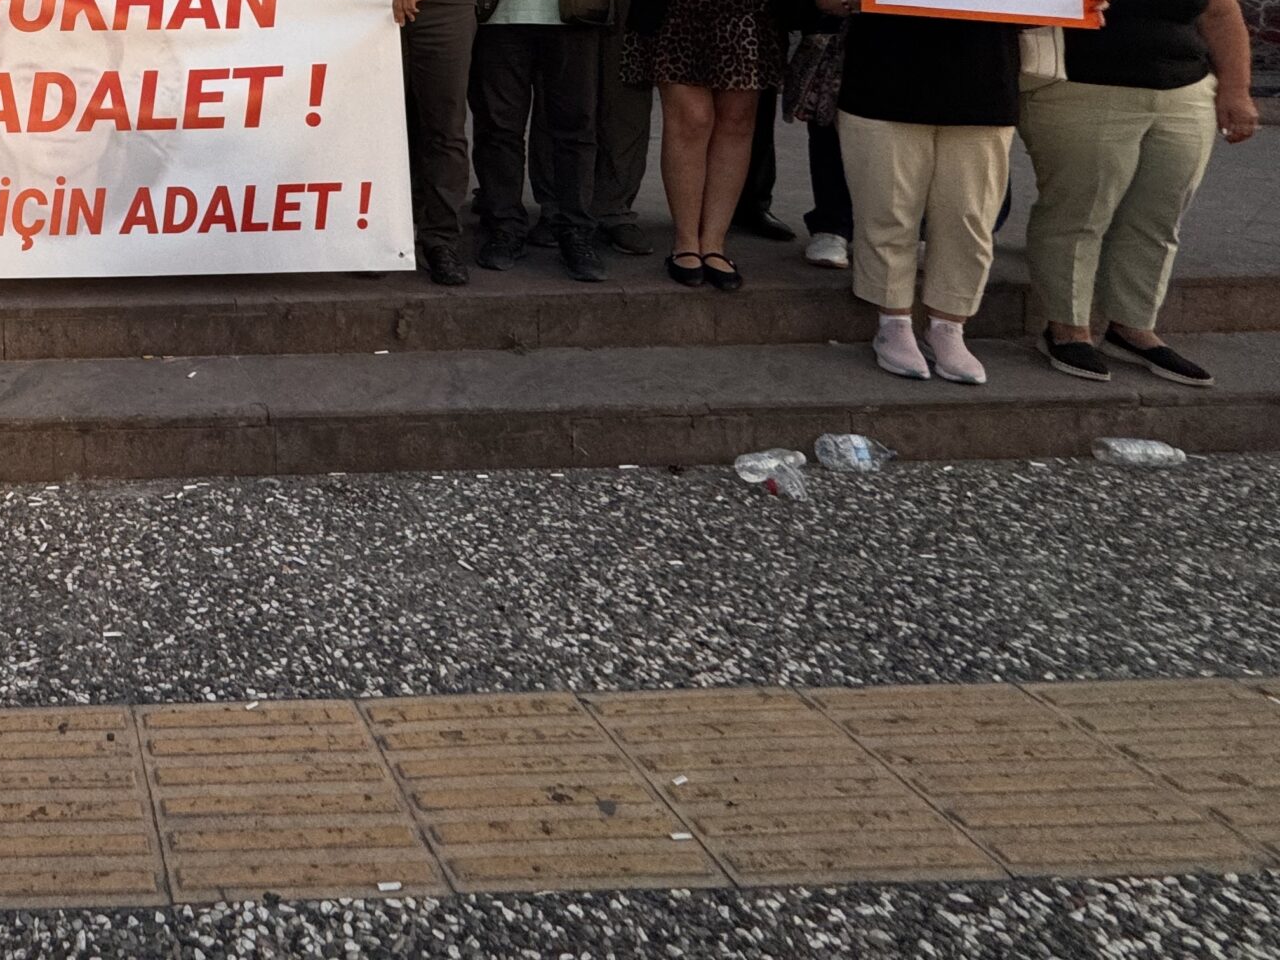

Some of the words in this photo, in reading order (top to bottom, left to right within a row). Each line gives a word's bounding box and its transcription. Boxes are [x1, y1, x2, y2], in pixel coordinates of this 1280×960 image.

[304, 64, 328, 127] !
[119, 182, 342, 235] ADALET
[355, 181, 372, 230] !
